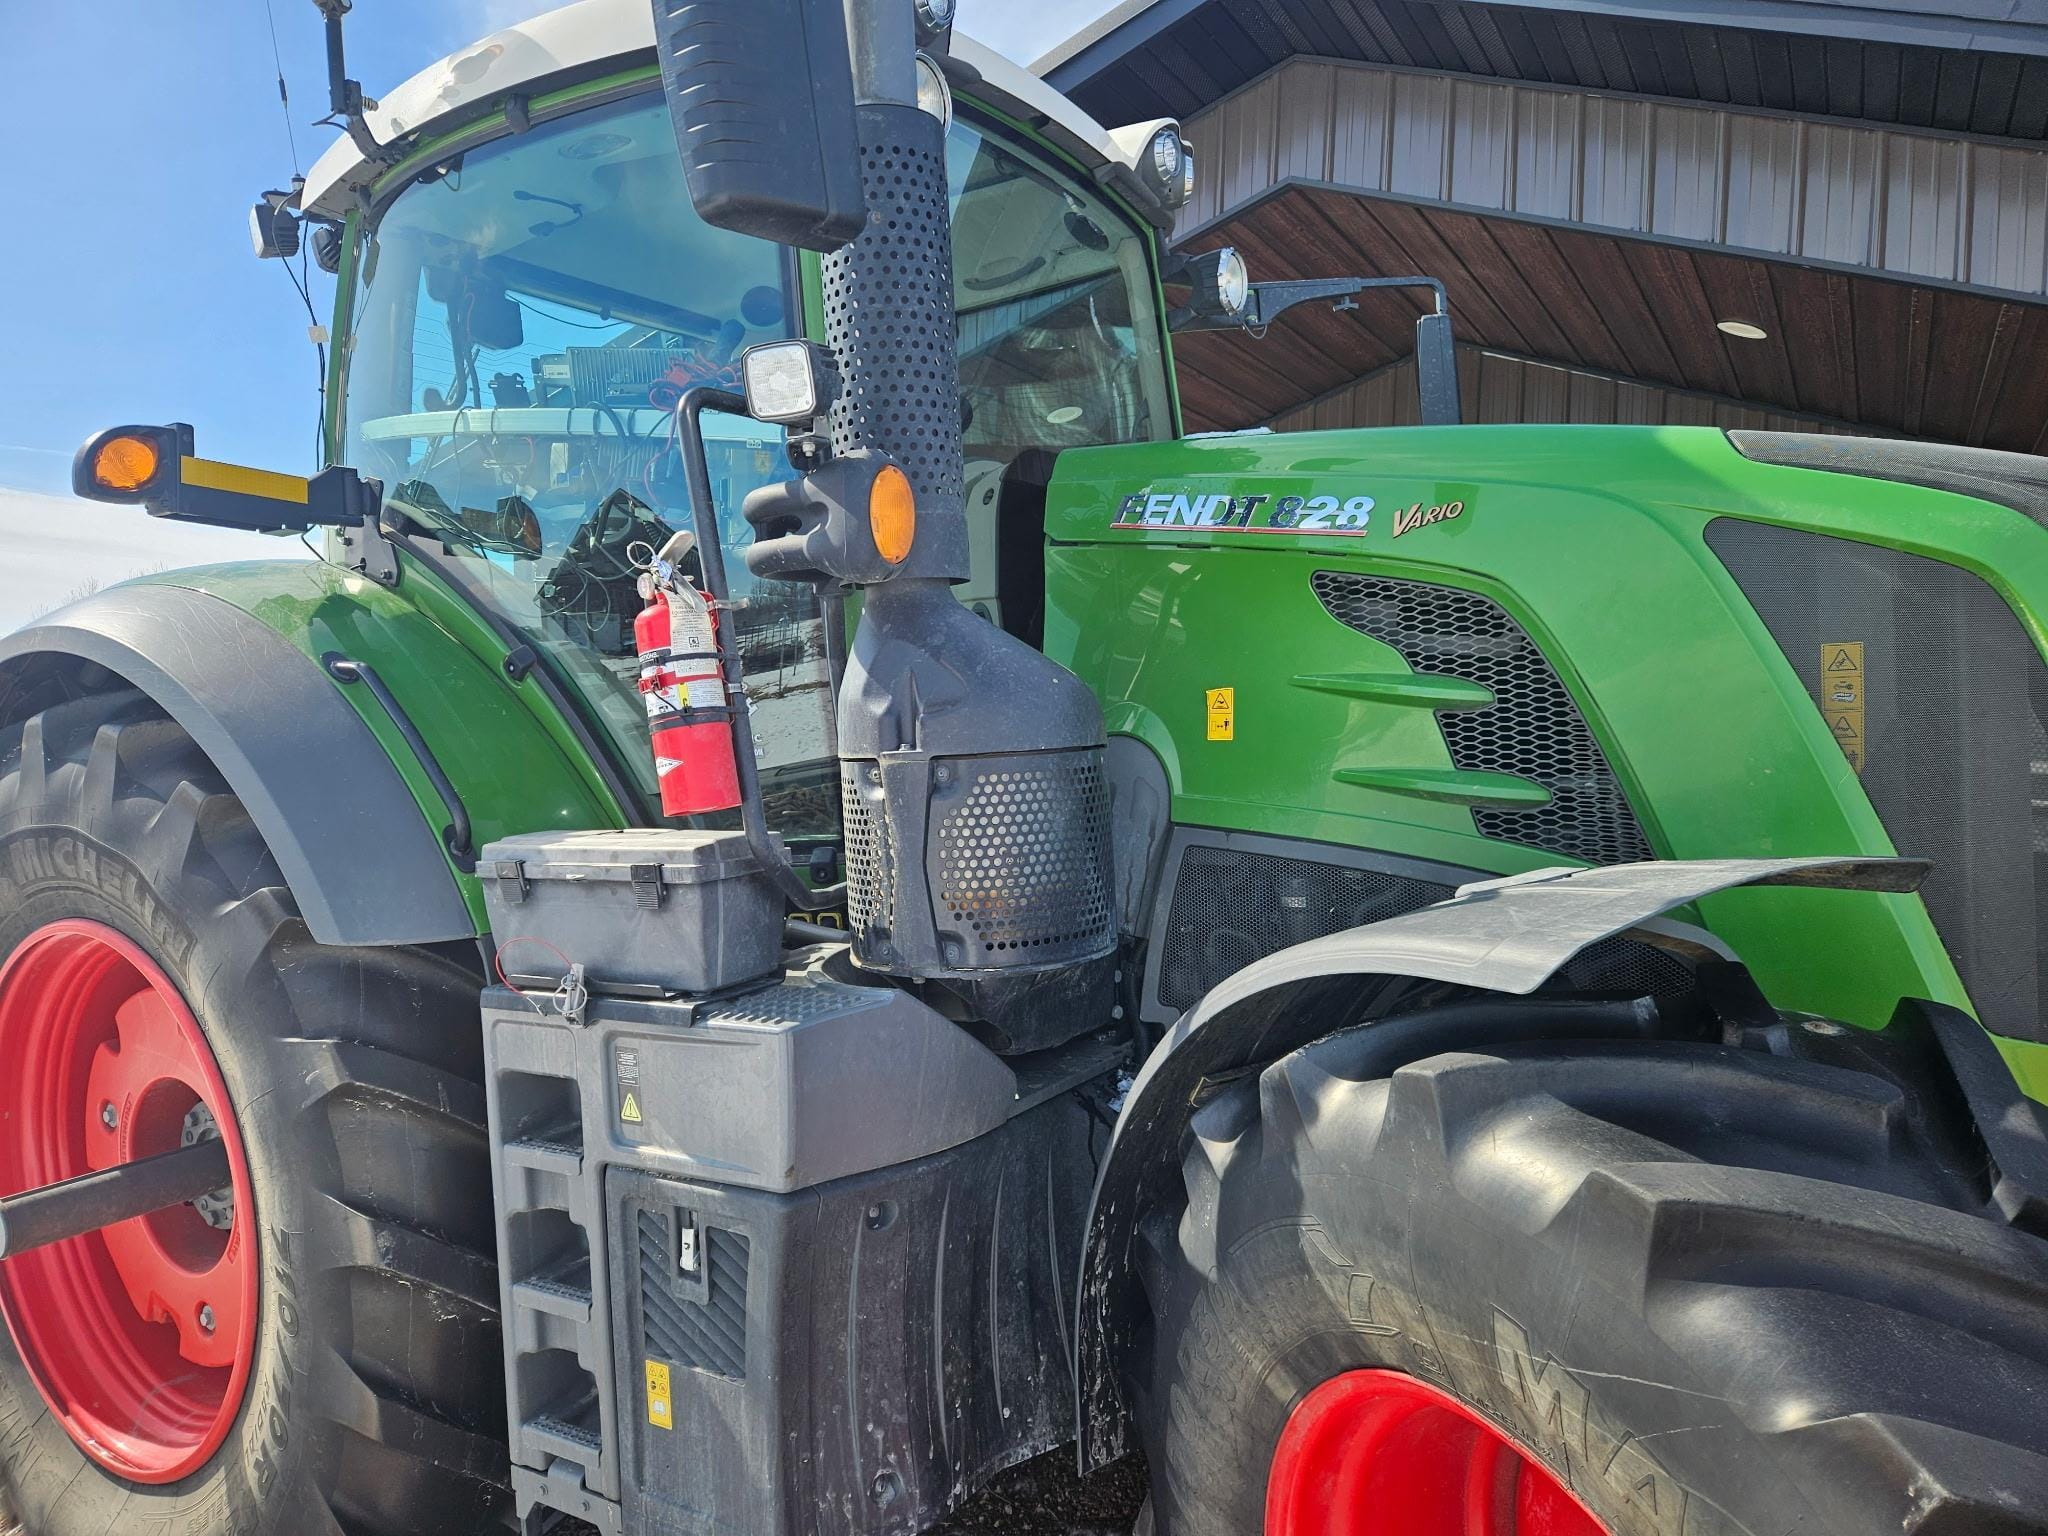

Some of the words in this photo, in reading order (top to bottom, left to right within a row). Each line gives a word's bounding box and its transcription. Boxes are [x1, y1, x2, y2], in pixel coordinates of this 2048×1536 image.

[1112, 492, 1271, 529] FENDT
[1267, 494, 1376, 531] 828
[8, 836, 190, 965] MICHELIN
